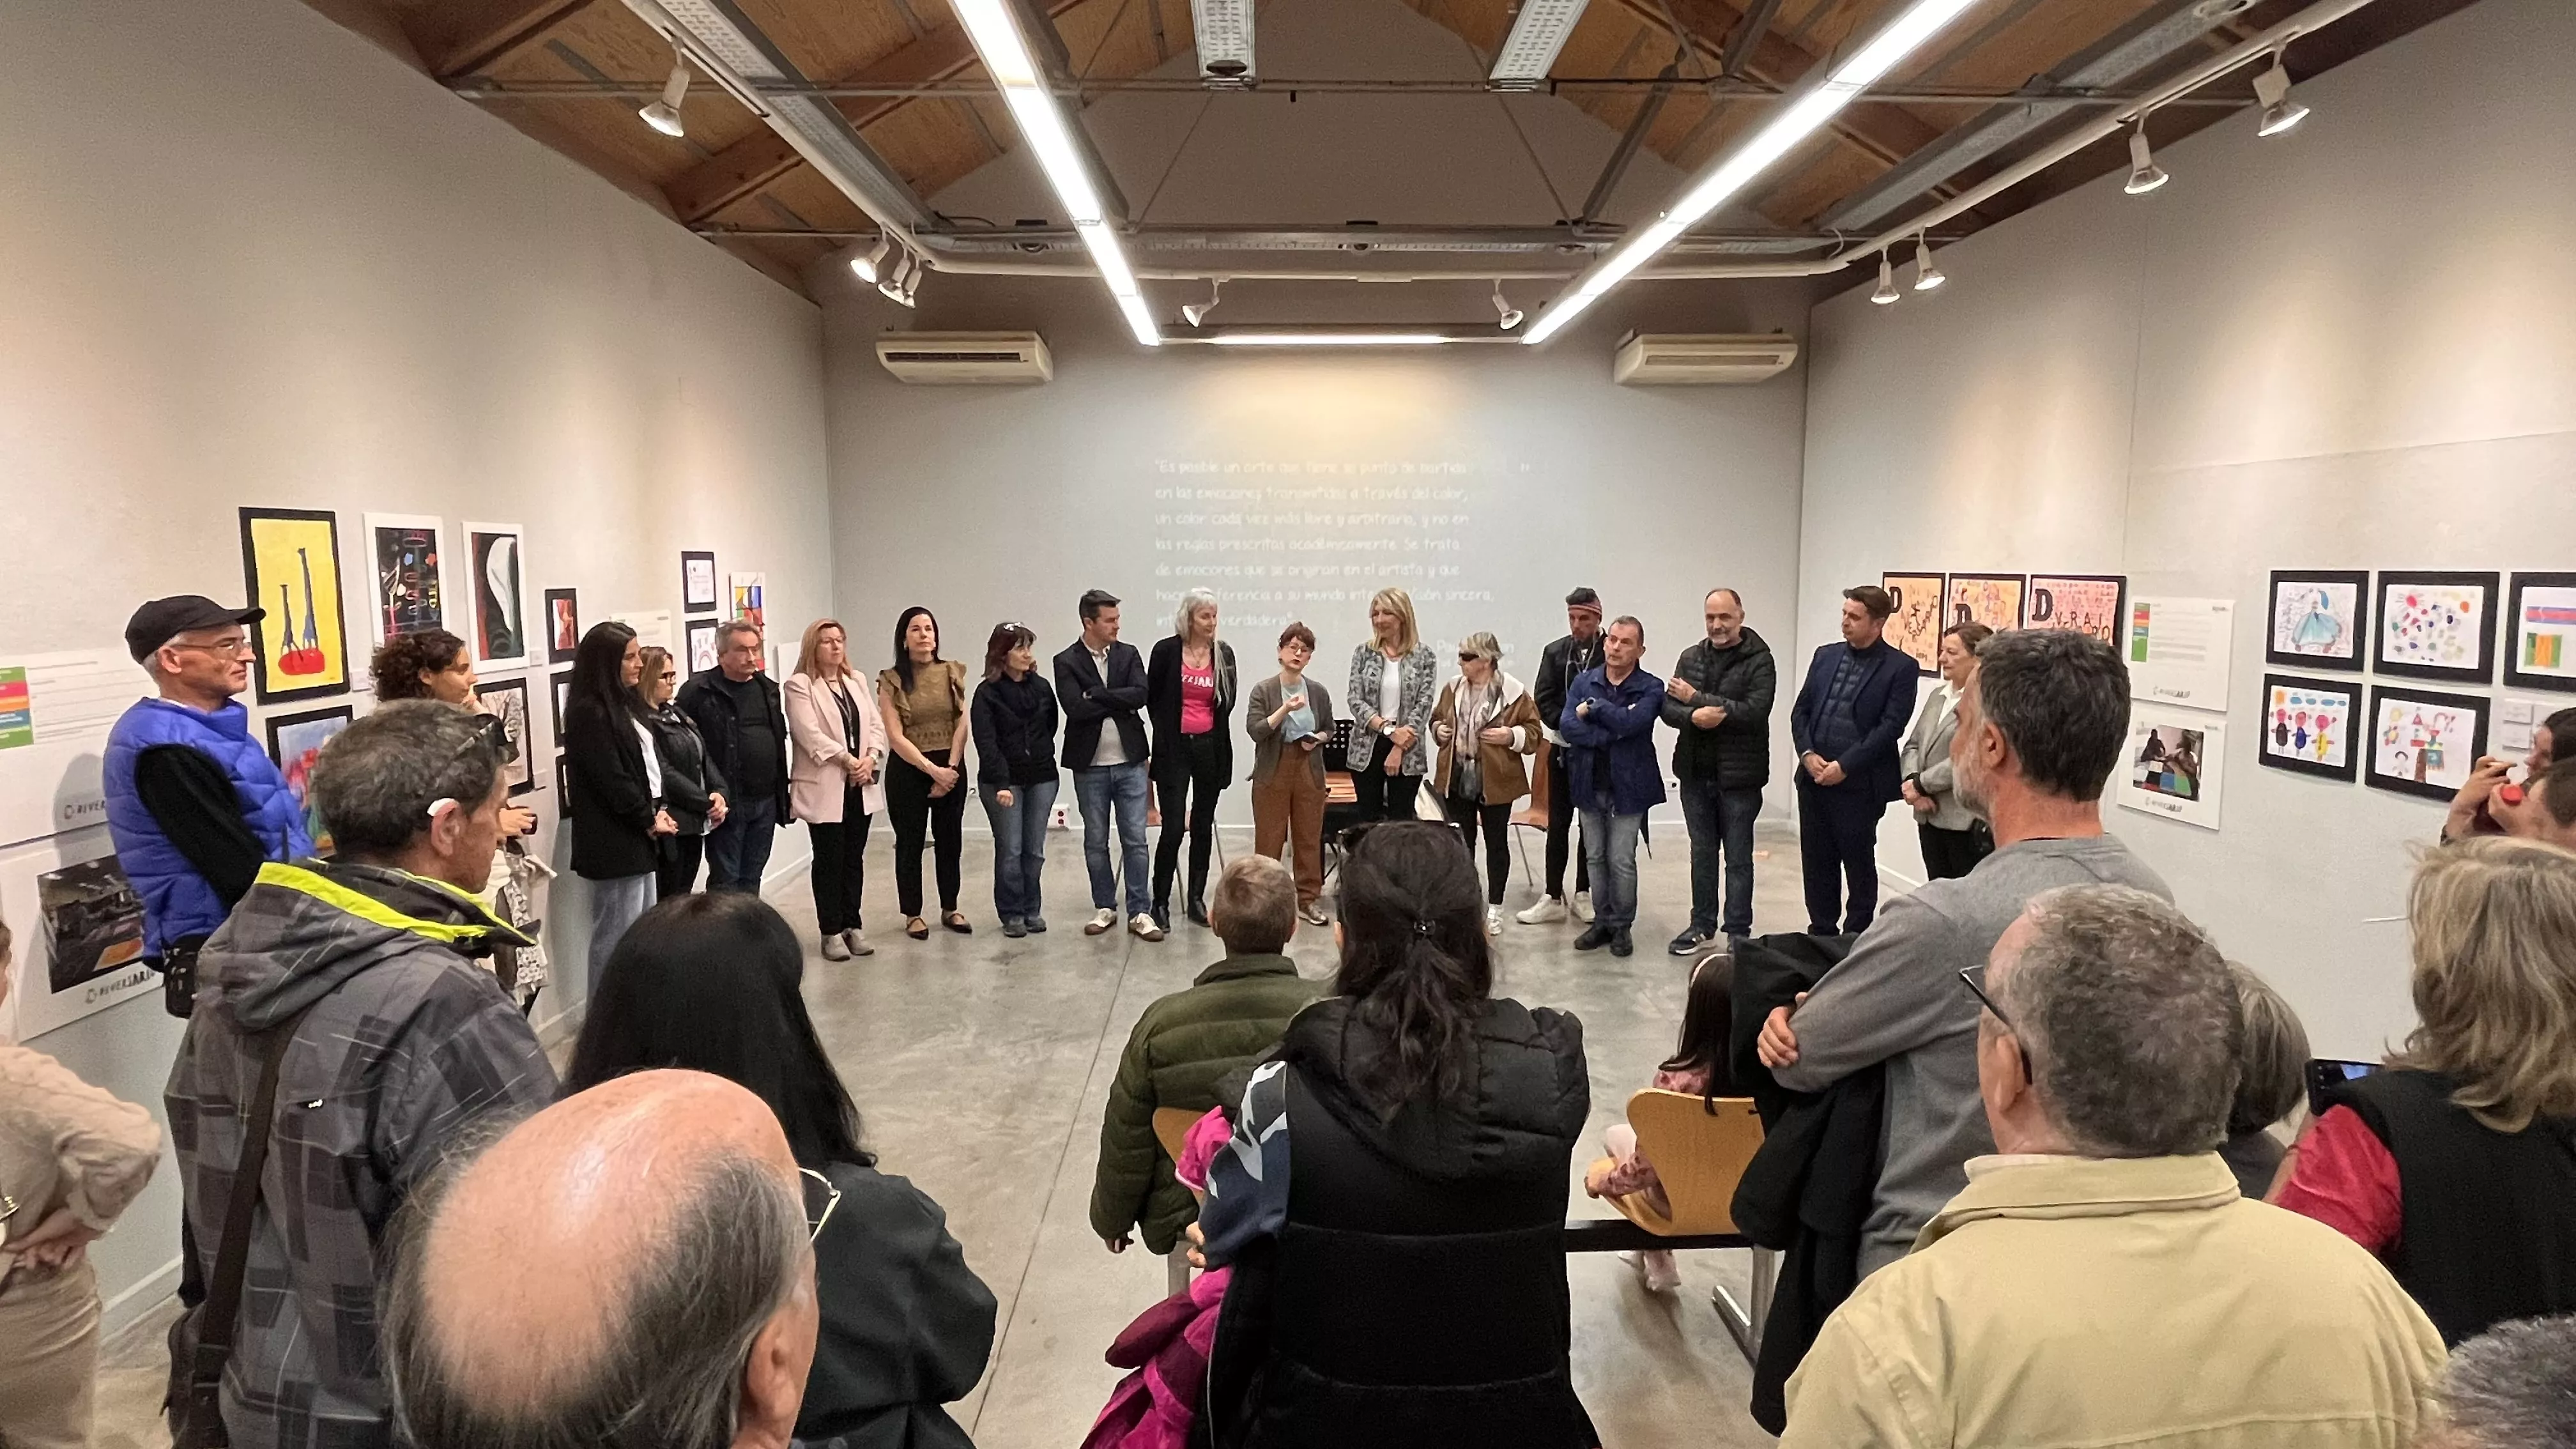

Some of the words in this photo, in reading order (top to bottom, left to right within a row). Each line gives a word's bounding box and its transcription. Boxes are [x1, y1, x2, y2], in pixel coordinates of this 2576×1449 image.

[1244, 461, 1274, 473] arte
[1155, 489, 1173, 500] en
[1176, 486, 1193, 500] las
[1411, 487, 1430, 500] del
[1155, 513, 1172, 525] un
[1211, 512, 1242, 526] cada
[1432, 514, 1449, 525] no
[1452, 514, 1470, 525] en
[1155, 536, 1172, 551] las
[1404, 537, 1420, 551] Se
[1423, 537, 1460, 551] trata
[1155, 562, 1171, 576] de
[1176, 564, 1240, 576] emociones
[1343, 565, 1361, 576] en
[1363, 562, 1376, 575] el
[1378, 562, 1424, 576] artista
[1439, 565, 1460, 578] que
